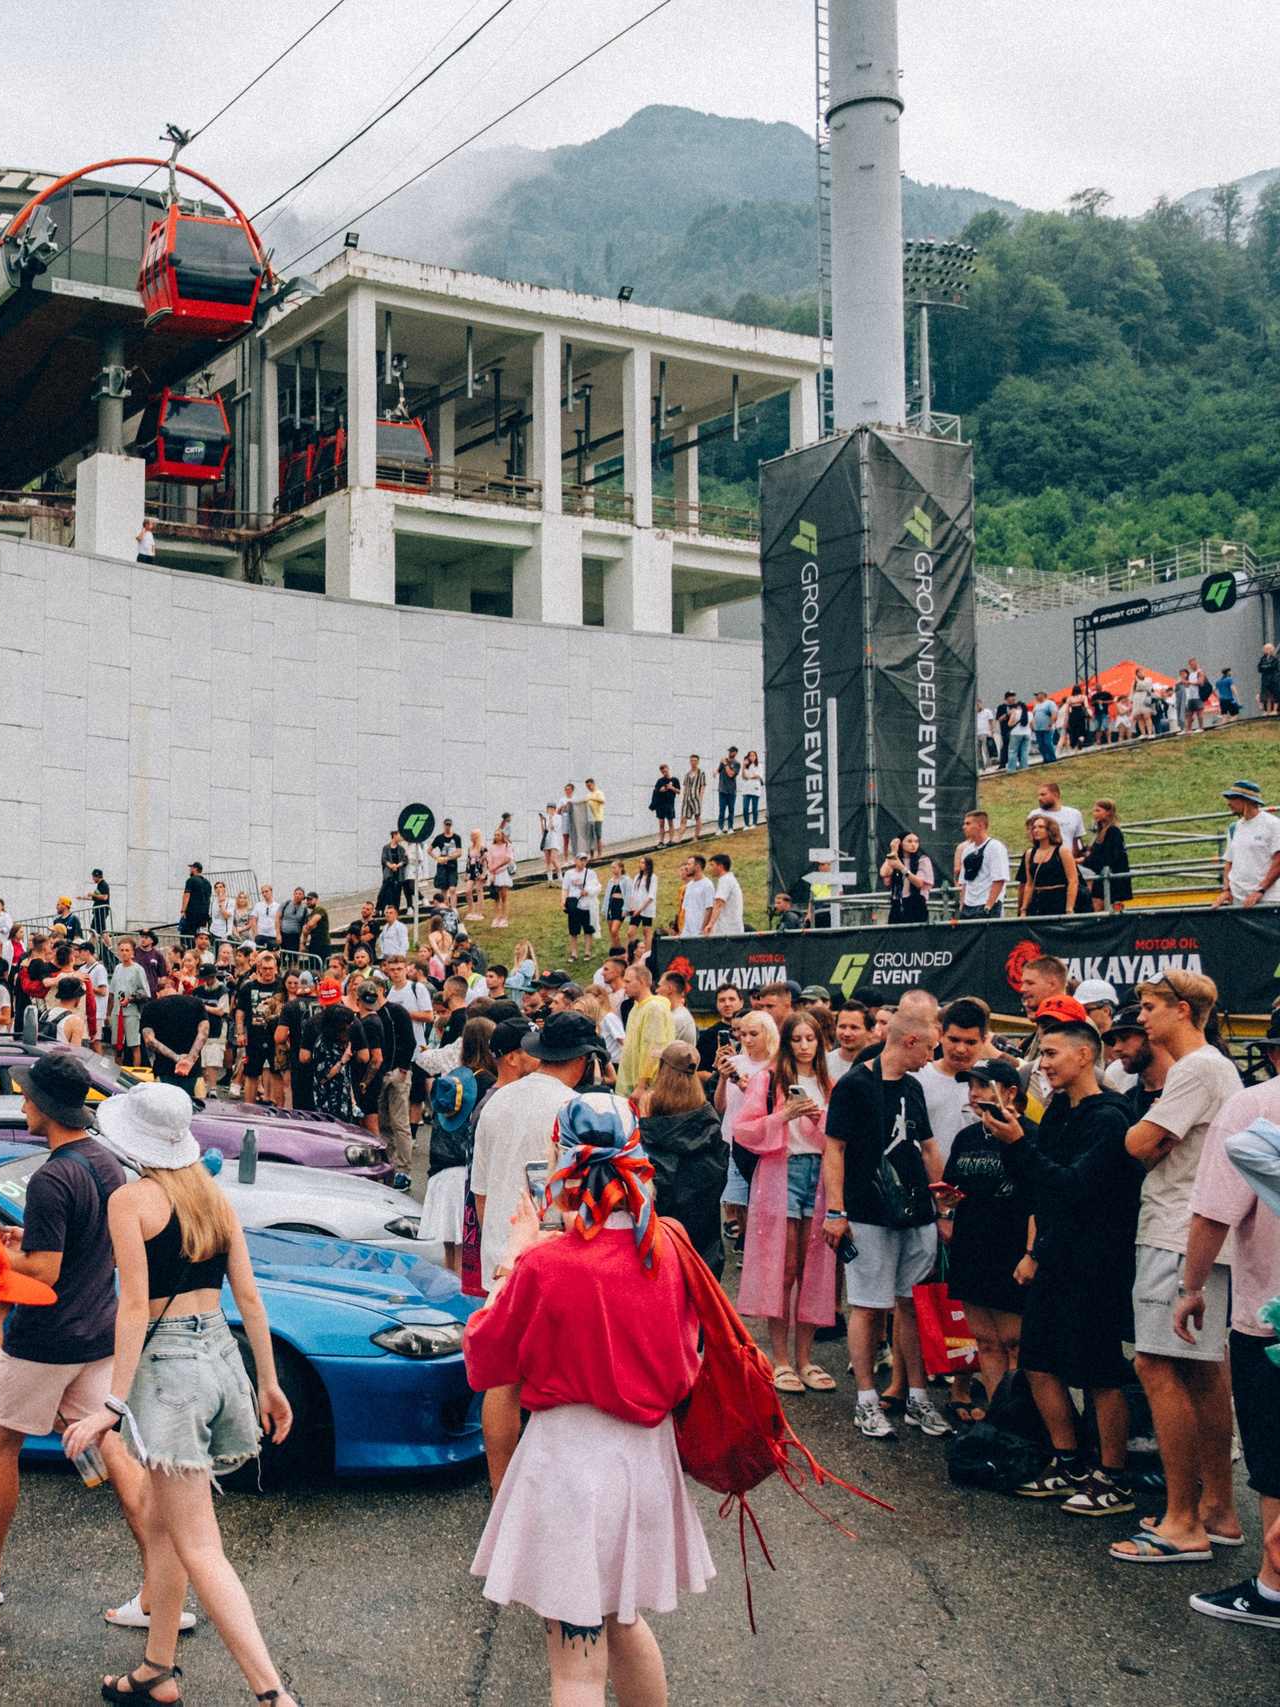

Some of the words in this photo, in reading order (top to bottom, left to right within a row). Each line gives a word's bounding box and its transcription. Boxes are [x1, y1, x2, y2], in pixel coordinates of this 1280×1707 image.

[1135, 938, 1178, 951] MOTOR
[1179, 938, 1199, 950] OIL
[748, 954, 772, 964] MOTOR
[773, 953, 786, 963] OIL
[873, 951, 953, 967] GROUNDED
[696, 966, 787, 991] TAKAYAMA
[872, 970, 922, 985] EVENT
